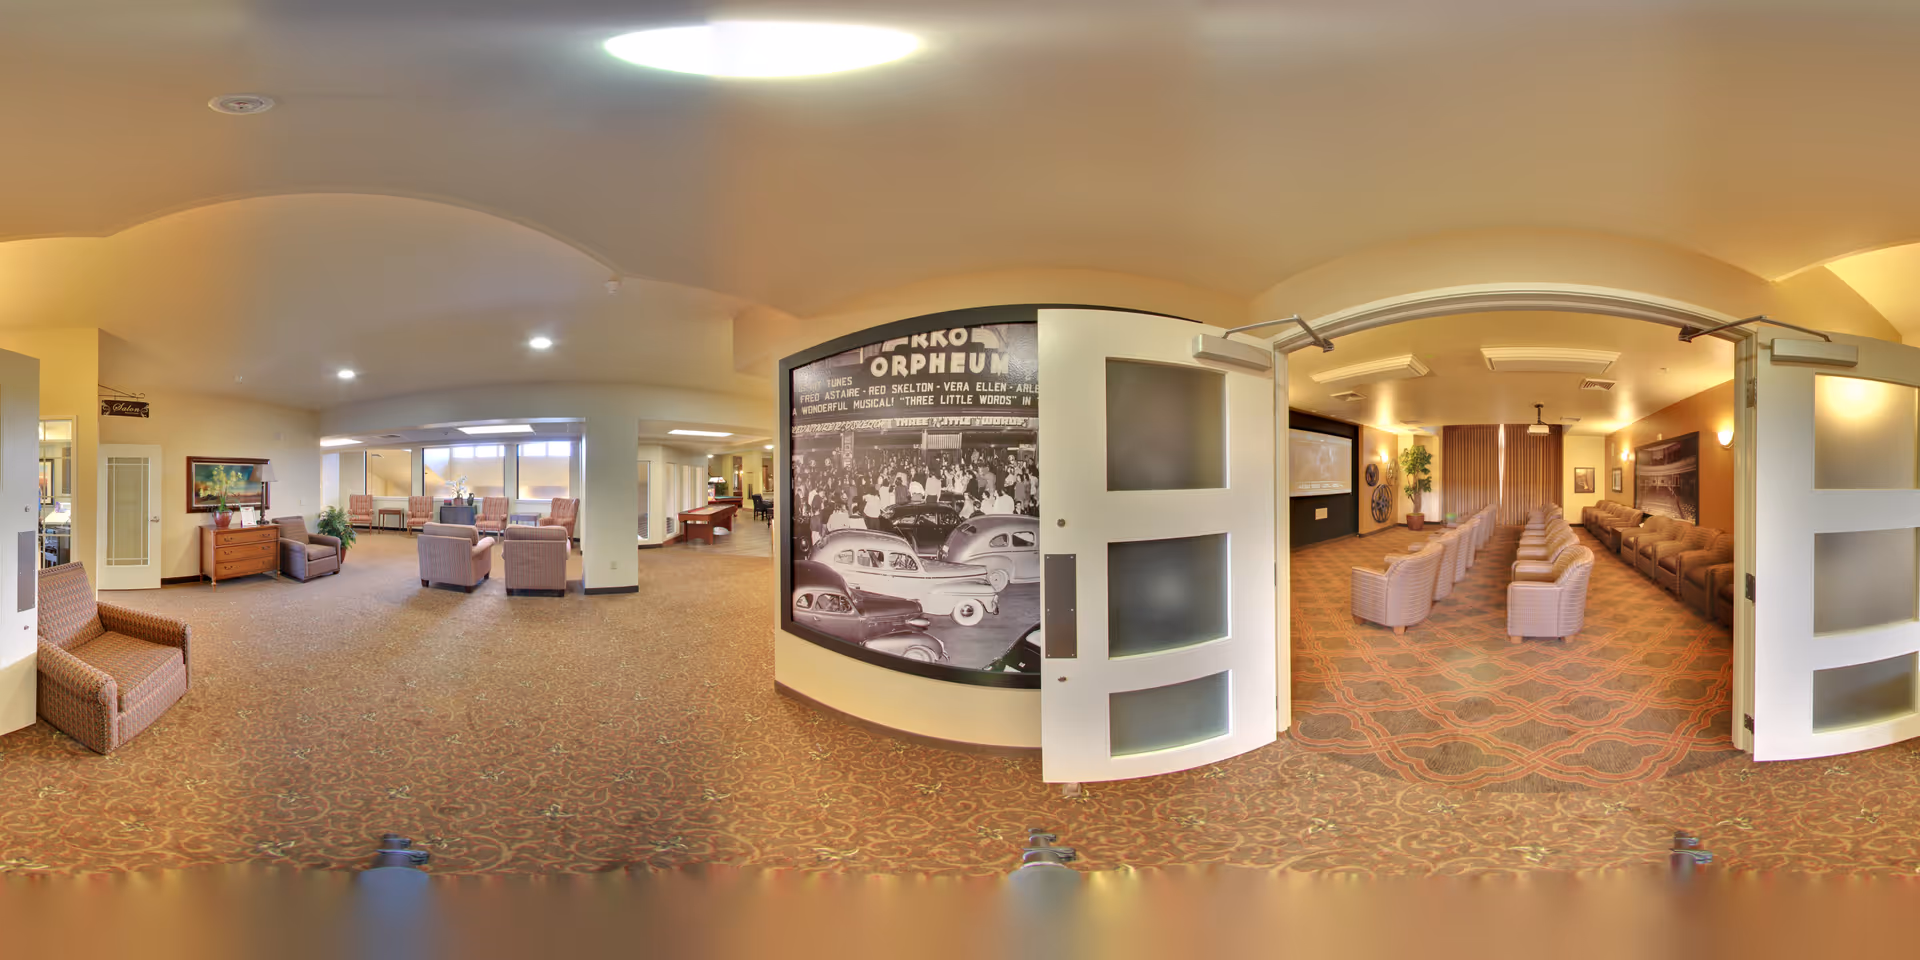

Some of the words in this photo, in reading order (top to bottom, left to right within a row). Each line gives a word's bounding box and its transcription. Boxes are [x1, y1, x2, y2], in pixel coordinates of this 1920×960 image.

[870, 352, 1009, 377] ORPHEUM
[800, 392, 820, 403] FRED
[825, 388, 860, 400] ASTAIRE
[868, 385, 886, 395] RED
[891, 382, 934, 394] SKELTON
[943, 381, 970, 392] VERA
[976, 382, 1007, 392] ELLEN
[827, 376, 852, 387] TUNES
[112, 402, 140, 412] Salon
[792, 408, 797, 416] A
[802, 402, 848, 415] WONDERFUL
[853, 397, 894, 409] MUSICAL!
[899, 395, 935, 406] "THREE
[940, 395, 973, 405] LITTLE
[979, 395, 1017, 406] WORDS"
[1022, 396, 1032, 406] IN
